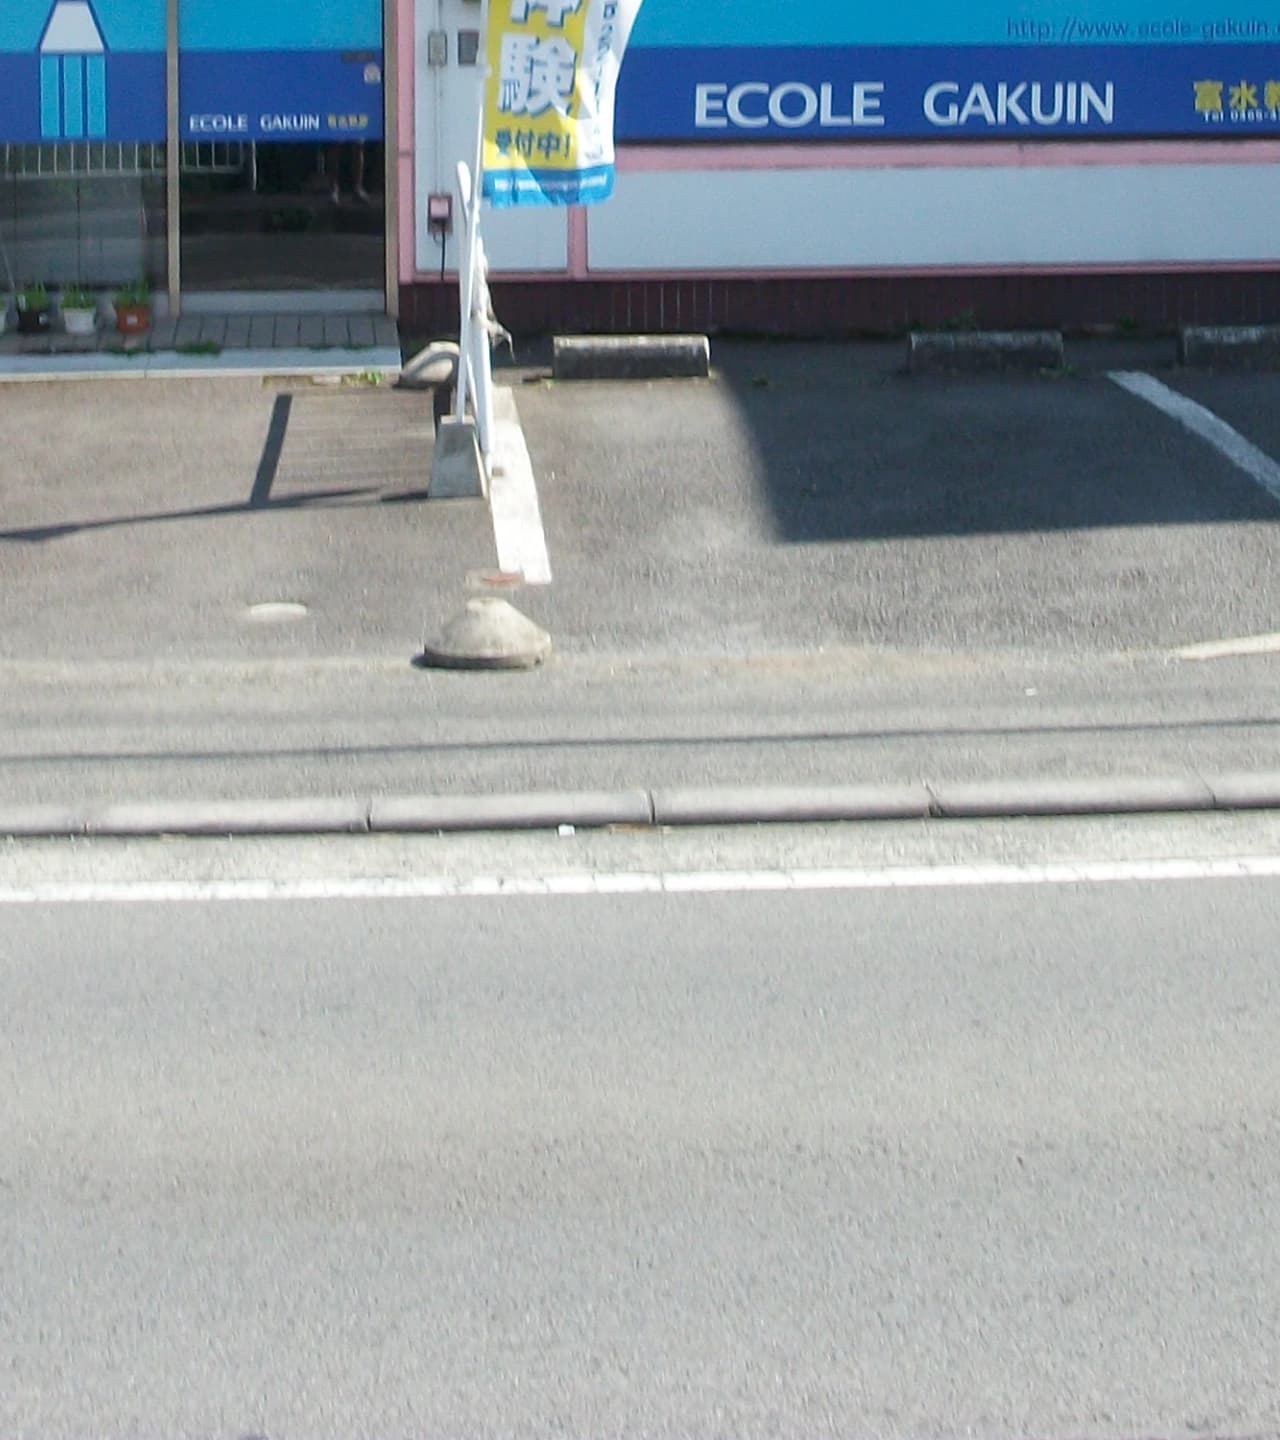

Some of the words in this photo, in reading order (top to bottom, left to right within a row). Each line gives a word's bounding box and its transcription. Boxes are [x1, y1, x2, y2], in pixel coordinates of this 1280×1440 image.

[694, 81, 885, 128] ECOLE
[922, 80, 1114, 127] GAKUIN
[189, 113, 249, 132] ECOLE
[260, 112, 320, 131] GAKUIN
